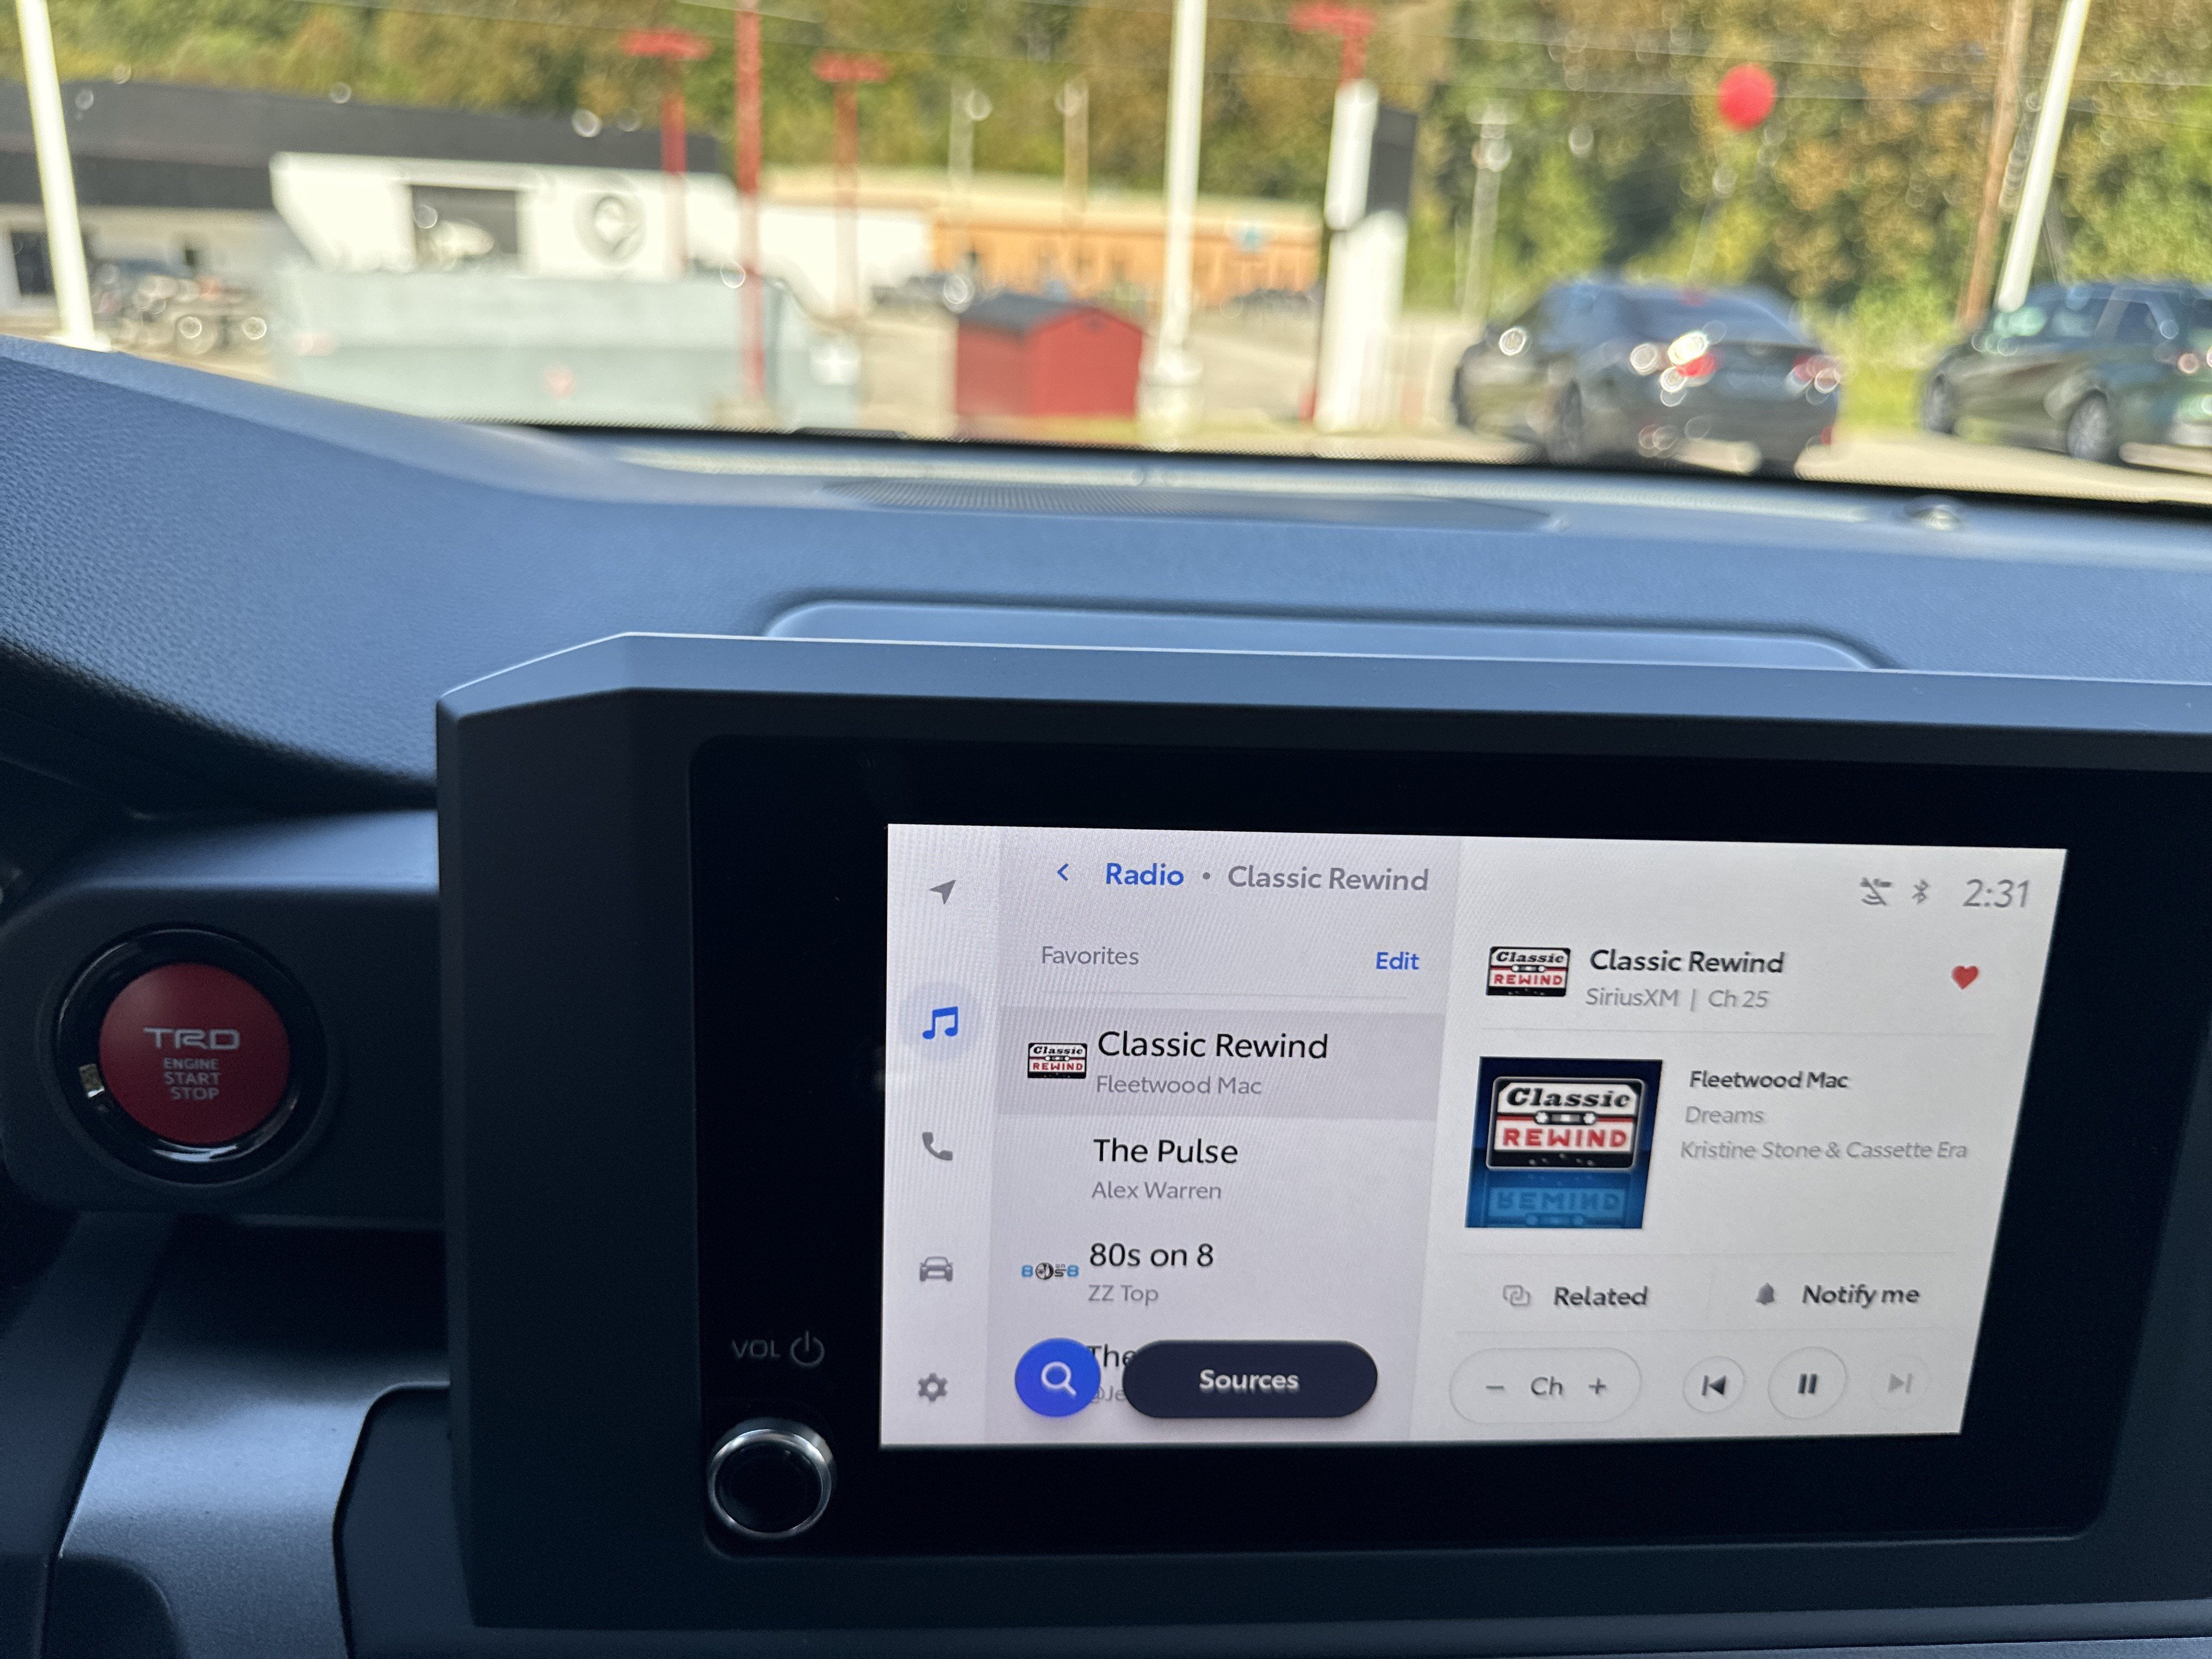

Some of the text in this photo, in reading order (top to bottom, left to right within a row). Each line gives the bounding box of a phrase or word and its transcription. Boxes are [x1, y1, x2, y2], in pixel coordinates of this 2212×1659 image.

[1105, 863, 1429, 892] Radio Classic Rewind
[1962, 879, 2030, 909] 2:31
[1041, 946, 1139, 967] Favorites
[1376, 951, 1420, 972] Edit
[1496, 951, 1564, 963] Classic
[1590, 950, 1785, 974] Classic Rewind
[1493, 974, 1562, 985] REWIND
[1585, 988, 1679, 1008] SiriusXM
[1708, 990, 1740, 1008] Ch
[1742, 990, 1768, 1008] 25
[144, 1027, 241, 1050] TRD
[1098, 1031, 1329, 1060] Classic Rewind
[163, 1058, 219, 1071] ENGINE
[165, 1072, 221, 1086] START
[1096, 1076, 1262, 1096] Fleetwood Mac
[1690, 1070, 1849, 1089] Fleetwood Mac
[172, 1087, 220, 1100] STOP
[1506, 1087, 1631, 1108] Classic
[1685, 1106, 1764, 1124] Dreams
[1503, 1128, 1627, 1147] REWIND
[1093, 1138, 1239, 1165] The Pulse
[1680, 1141, 1968, 1159] Kristine Stone & Cassette Era
[1092, 1181, 1222, 1201] Alex Warren
[1089, 1242, 1214, 1268] 80s on 8
[1088, 1284, 1159, 1306] ZZ Top
[1554, 1285, 1649, 1308] Related
[1802, 1284, 1920, 1310] Notify me
[731, 1339, 781, 1359] VOL
[1199, 1369, 1299, 1391] Sources
[1531, 1376, 1564, 1397] Ch
